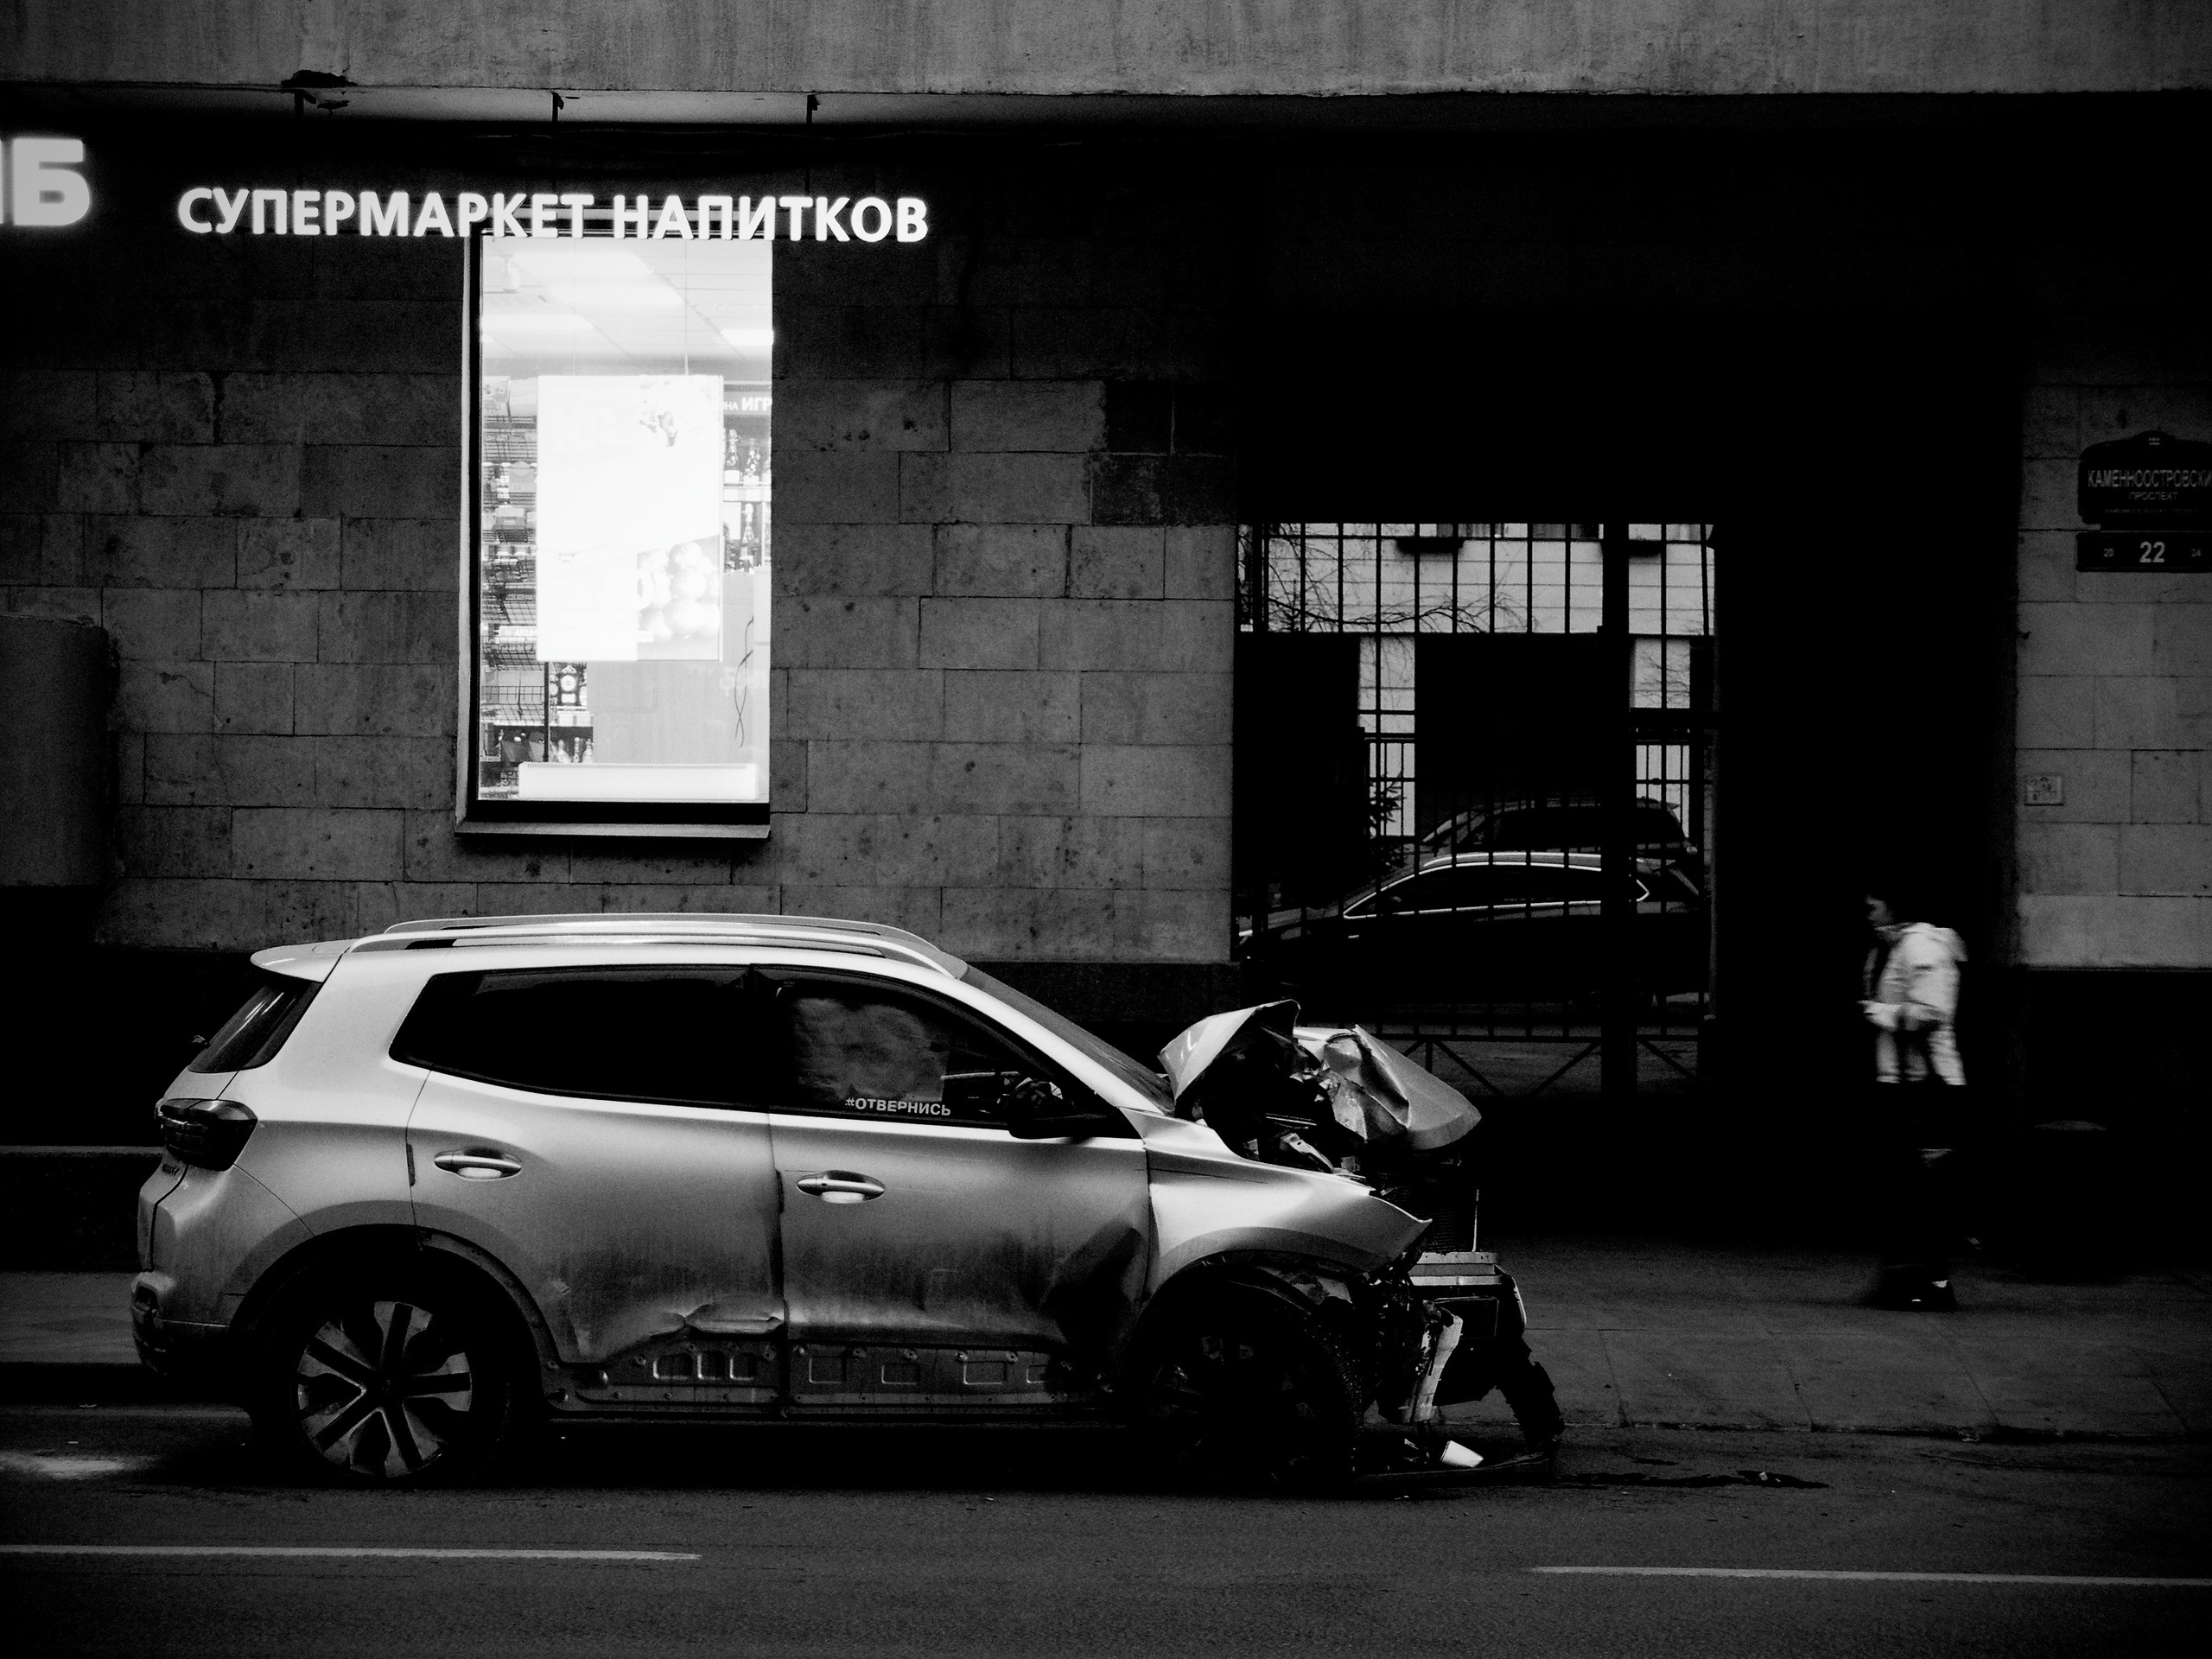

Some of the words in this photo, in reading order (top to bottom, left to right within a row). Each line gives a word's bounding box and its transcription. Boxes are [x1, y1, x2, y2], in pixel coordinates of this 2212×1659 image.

[0, 137, 91, 226] Б
[178, 188, 594, 238] СУПЕРМАРКЕТ
[613, 194, 929, 243] НАПИТКОВ
[2129, 491, 2178, 500] ПРОСПЕКТ
[2139, 541, 2166, 563] 22
[845, 1097, 951, 1116] #ОТВЕРНИСЬ
